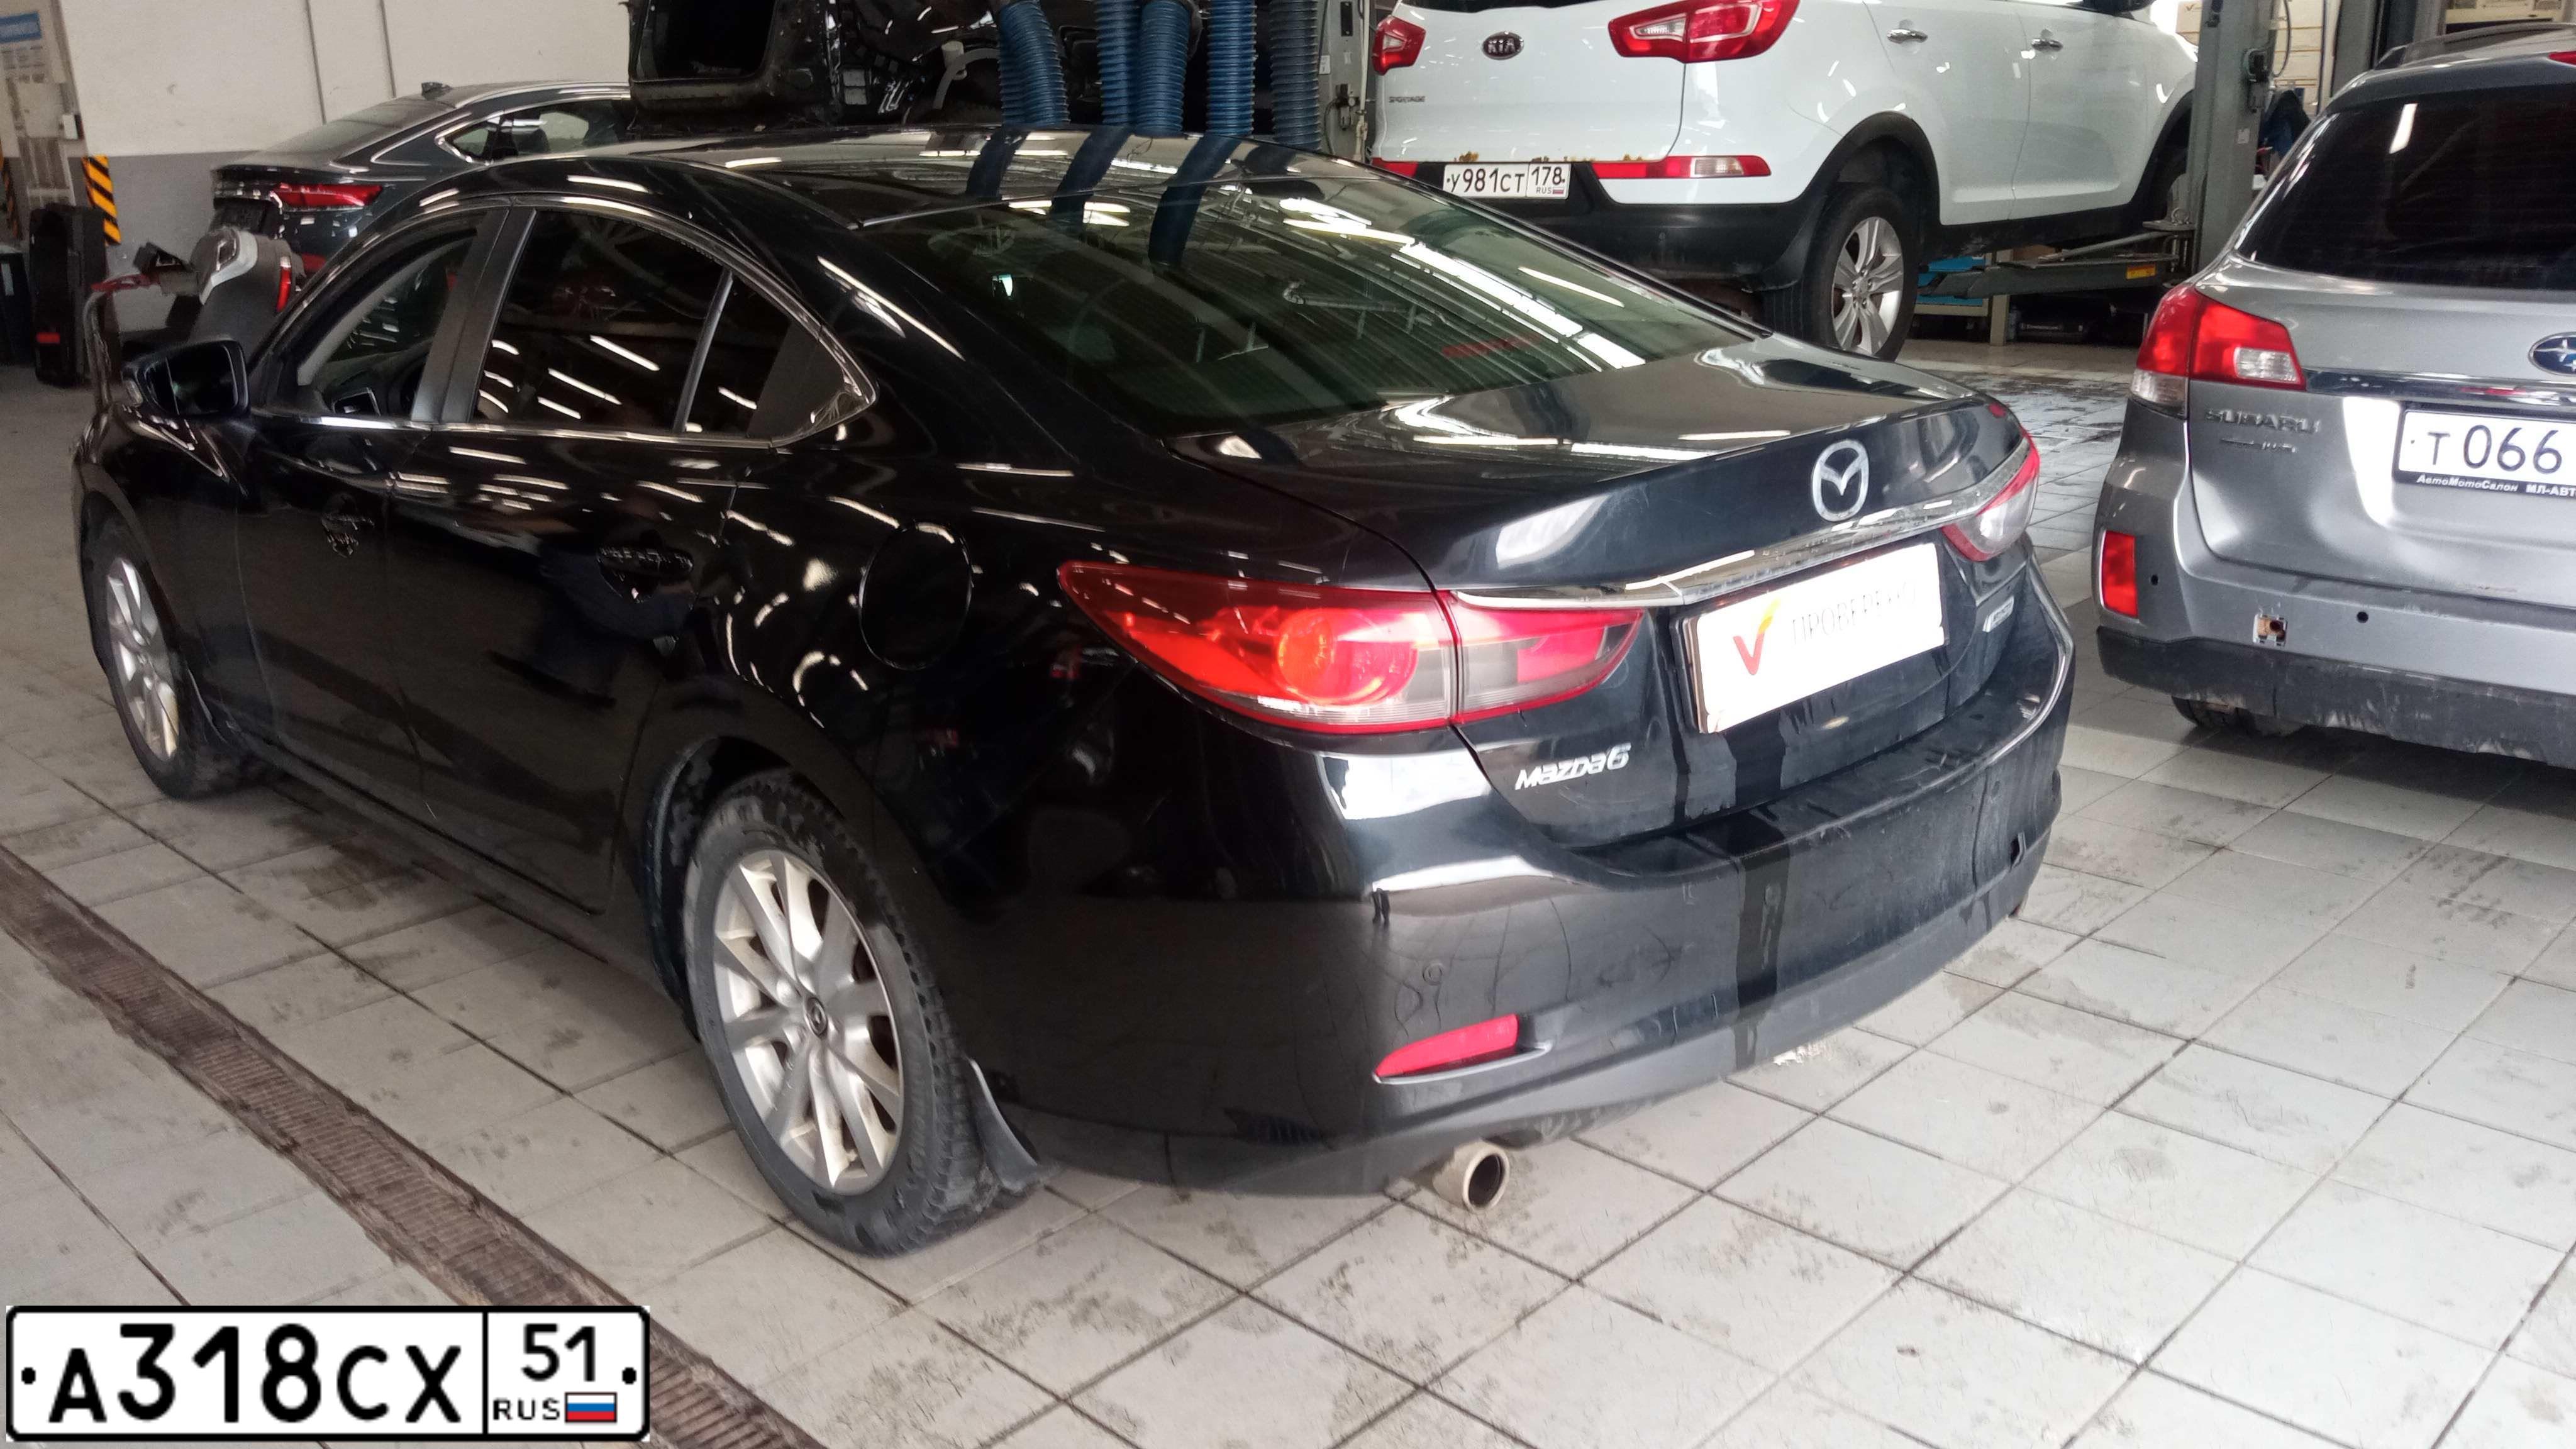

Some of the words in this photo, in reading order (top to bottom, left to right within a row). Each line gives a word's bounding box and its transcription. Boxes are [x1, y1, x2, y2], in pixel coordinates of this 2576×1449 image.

[1487, 38, 1516, 53] KIA
[1451, 167, 1525, 193] У981СТ
[1531, 166, 1563, 186] 178
[2417, 474, 2519, 492] АвтоМотоСалон
[2526, 484, 2576, 497] МЛ-АВТ
[1792, 580, 1916, 645] ПРОВЕРЕО
